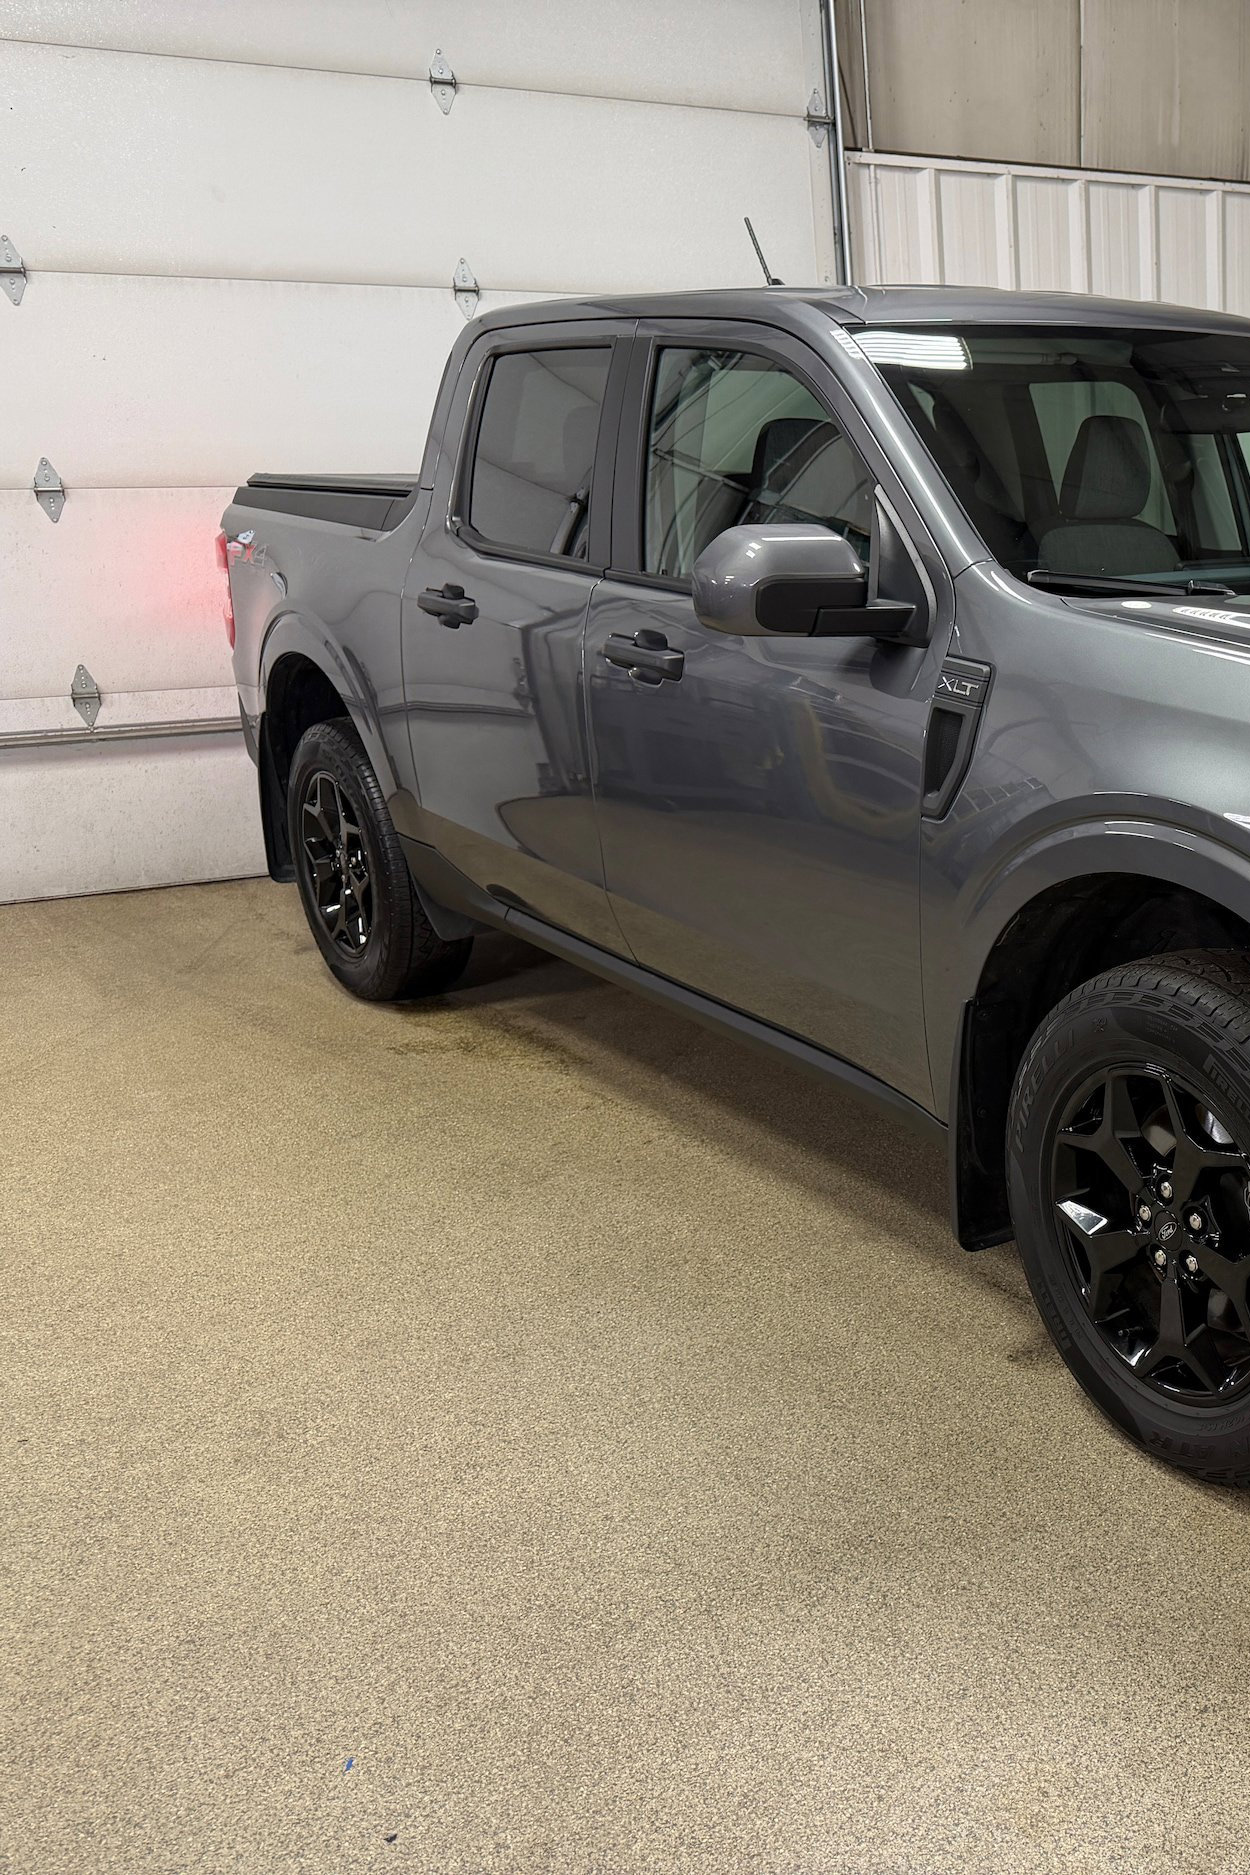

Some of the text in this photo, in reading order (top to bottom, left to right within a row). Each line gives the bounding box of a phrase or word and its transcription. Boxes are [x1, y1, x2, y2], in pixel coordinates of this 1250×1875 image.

[230, 542, 268, 568] FX4
[937, 676, 979, 696] XLT
[1014, 1029, 1076, 1153] PIRELLI
